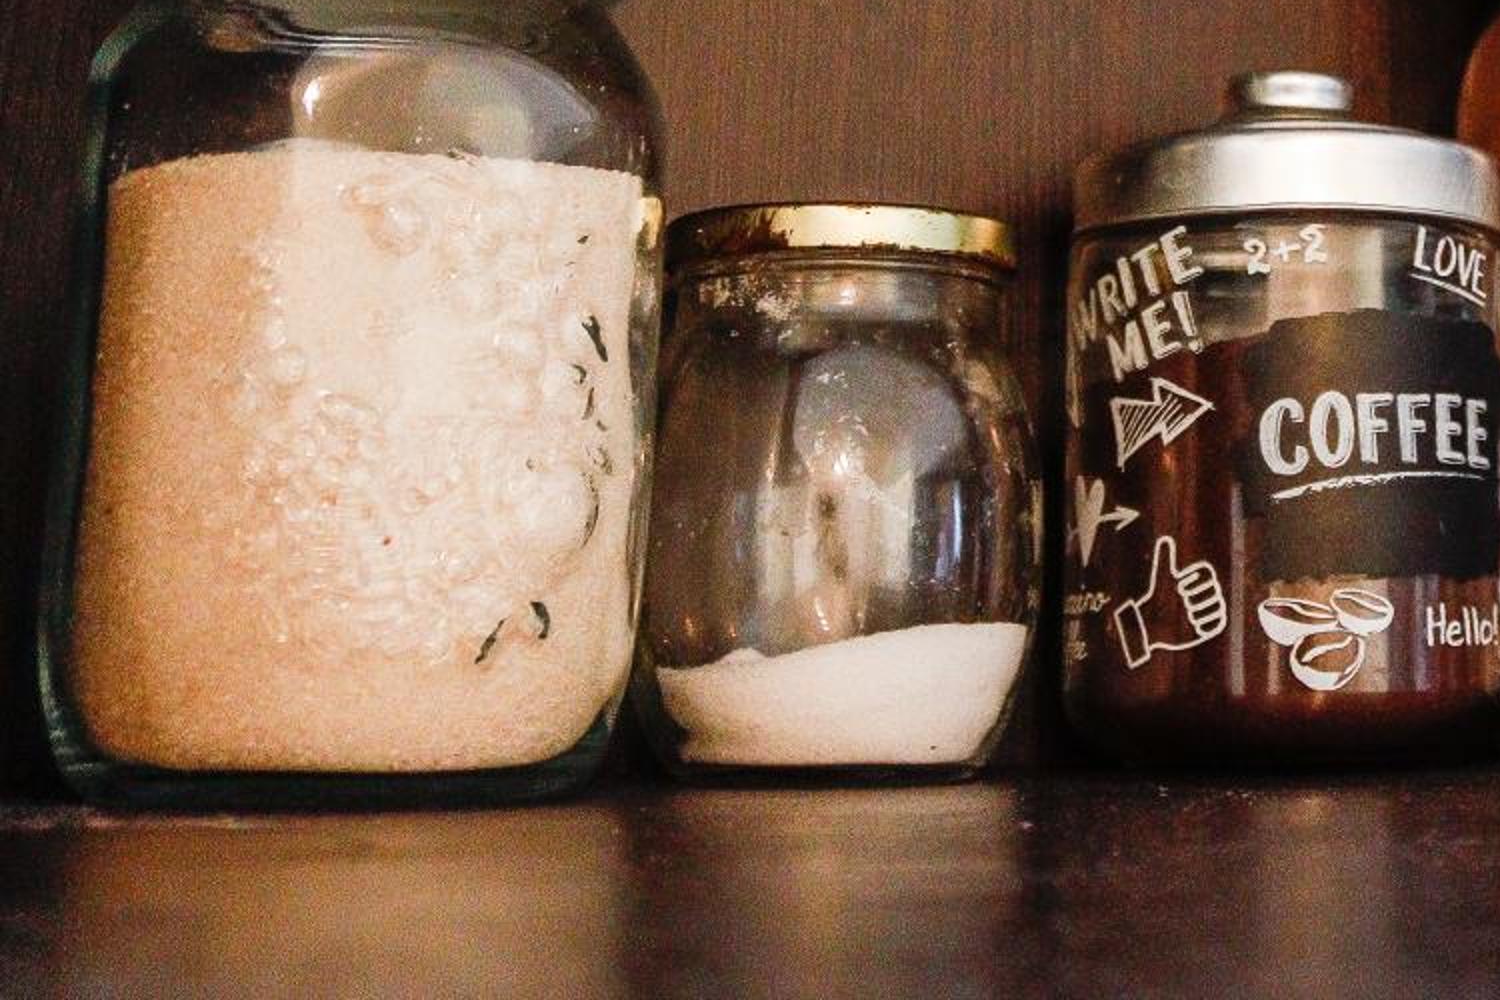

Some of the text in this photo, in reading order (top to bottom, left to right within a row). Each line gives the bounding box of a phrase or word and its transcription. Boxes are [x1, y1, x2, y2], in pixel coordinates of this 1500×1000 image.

[1073, 224, 1205, 351] WRITE
[1413, 226, 1488, 299] LOVE
[1105, 291, 1205, 383] ME!
[1258, 390, 1491, 475] COFFEE
[1426, 602, 1499, 648] Hello!
